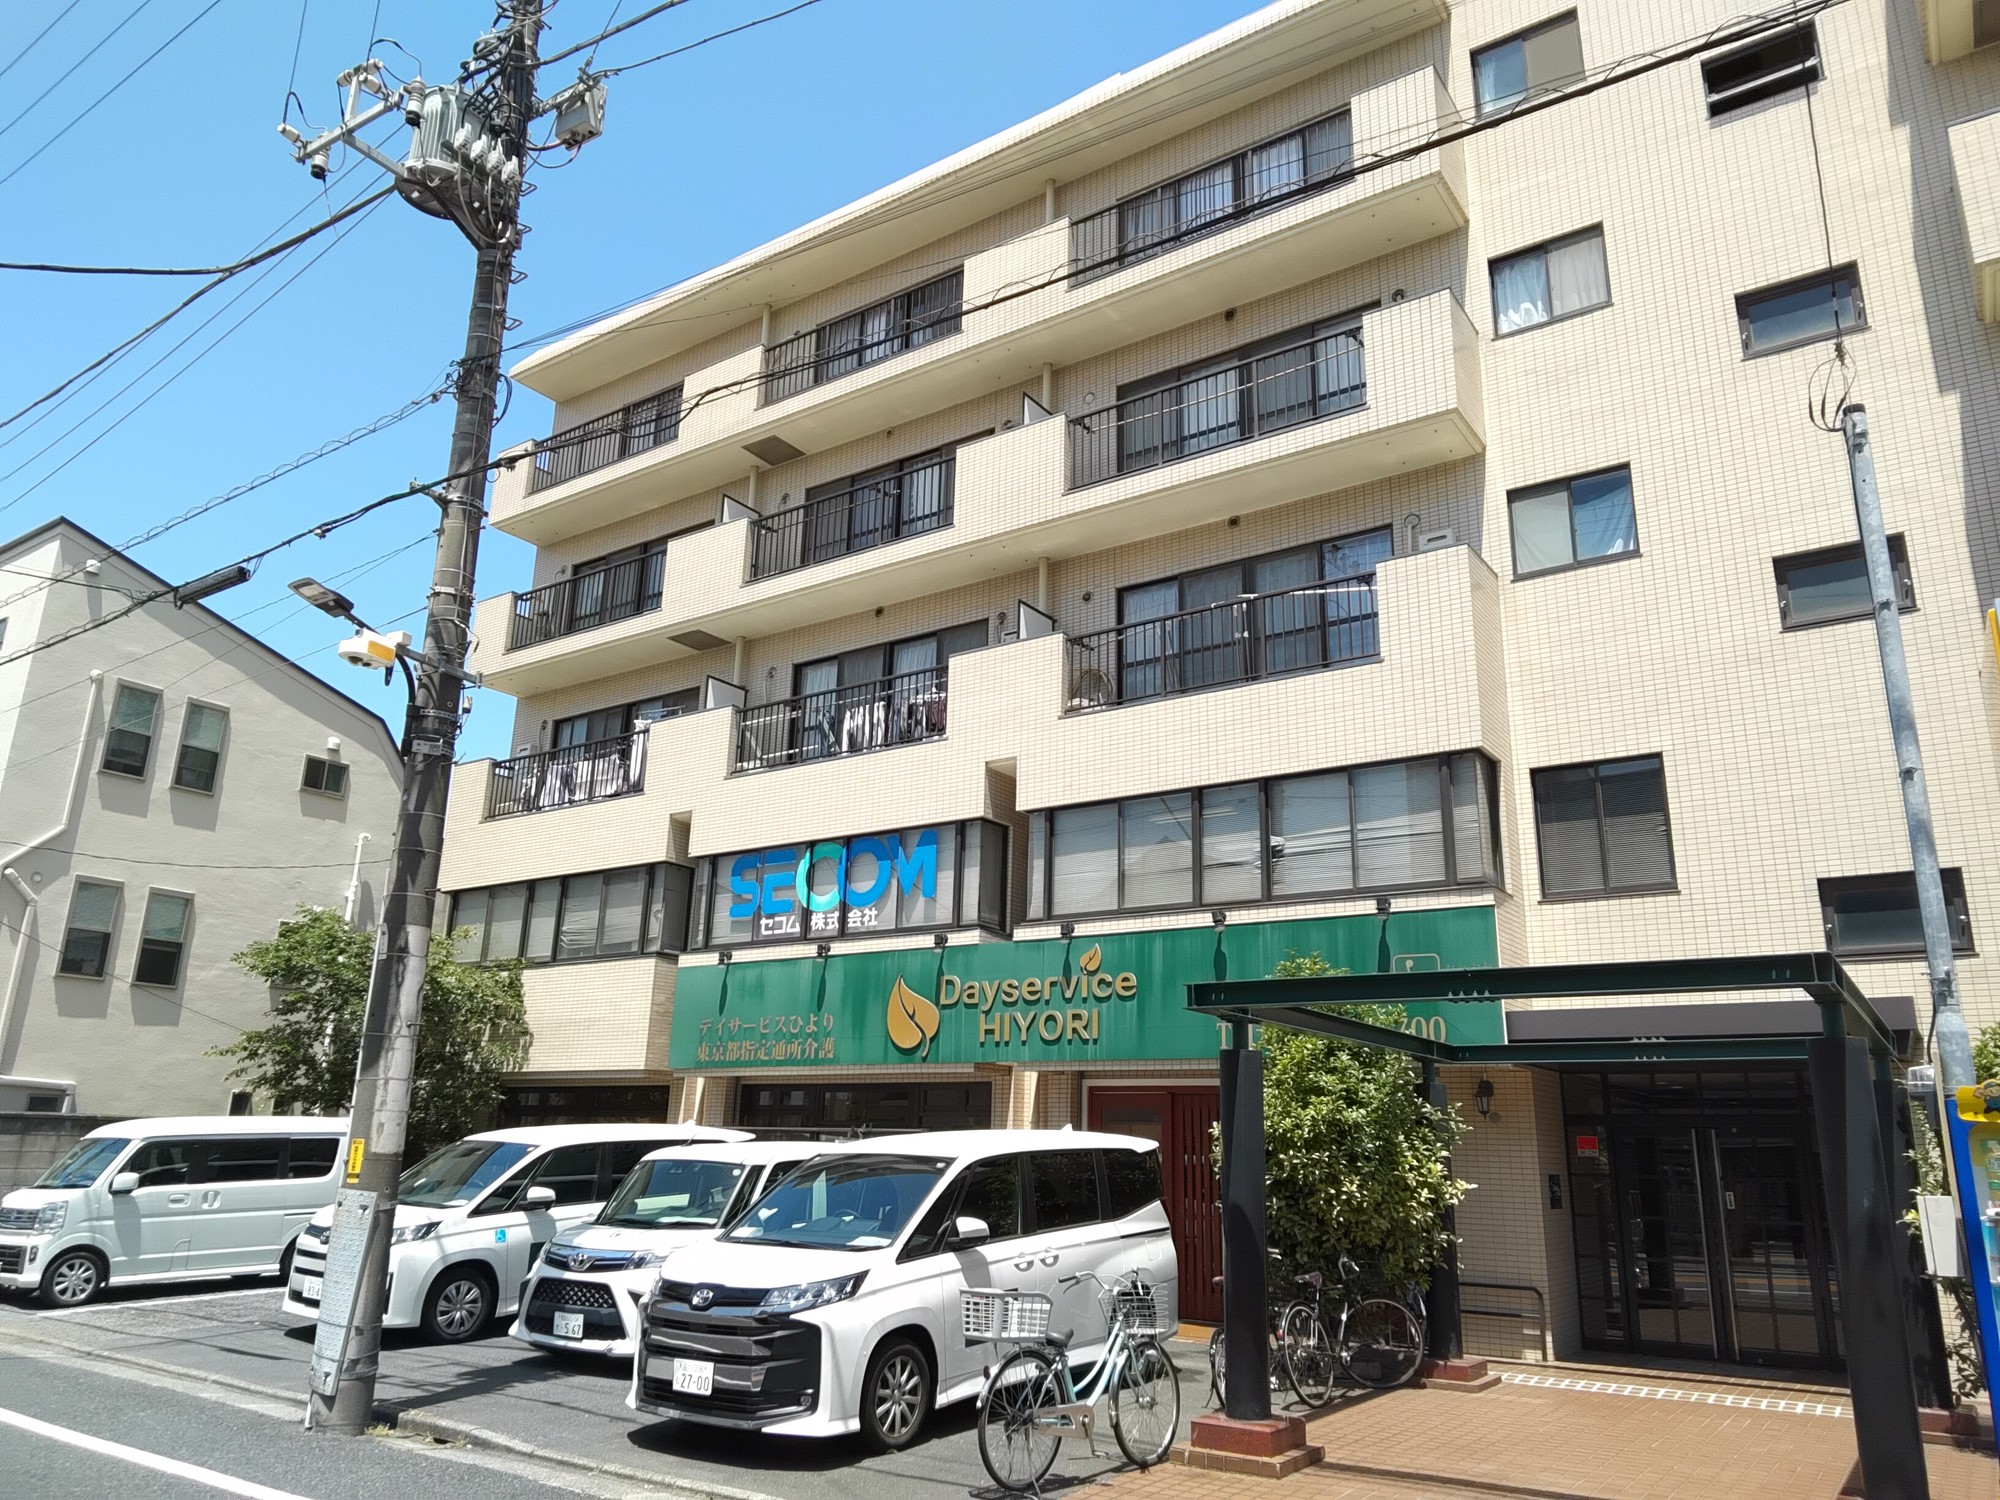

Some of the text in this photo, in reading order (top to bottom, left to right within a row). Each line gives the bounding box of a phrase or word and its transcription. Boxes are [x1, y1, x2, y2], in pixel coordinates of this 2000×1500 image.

[729, 829, 938, 919] SECOM
[940, 971, 1137, 1012] Dayservice
[699, 1013, 834, 1037] デイサービスひより
[979, 1008, 1099, 1043] HIYORI
[697, 1037, 835, 1062] 東京都指定通所介護
